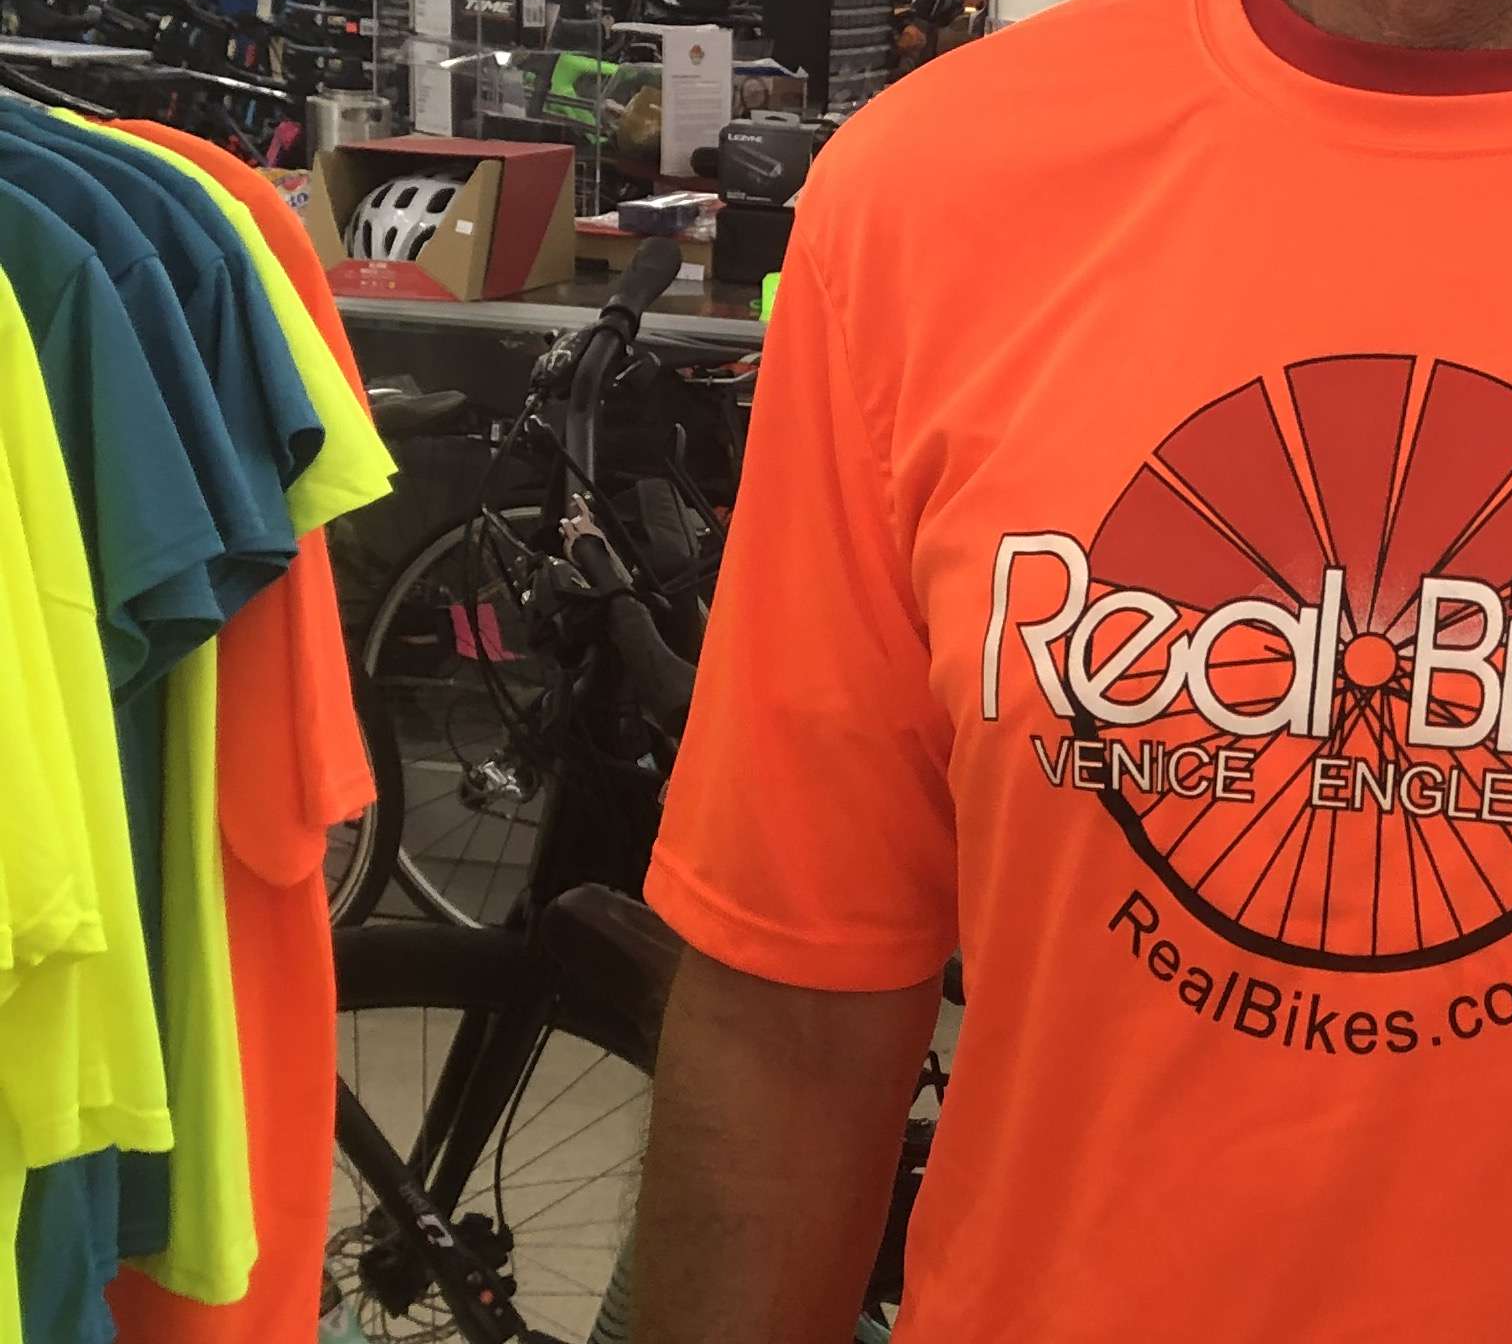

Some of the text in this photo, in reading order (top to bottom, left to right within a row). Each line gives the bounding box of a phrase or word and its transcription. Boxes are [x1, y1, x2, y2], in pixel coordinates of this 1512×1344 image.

[465, 0, 516, 14] TIME
[982, 531, 1346, 739] Real
[1030, 735, 1256, 803] VENICE
